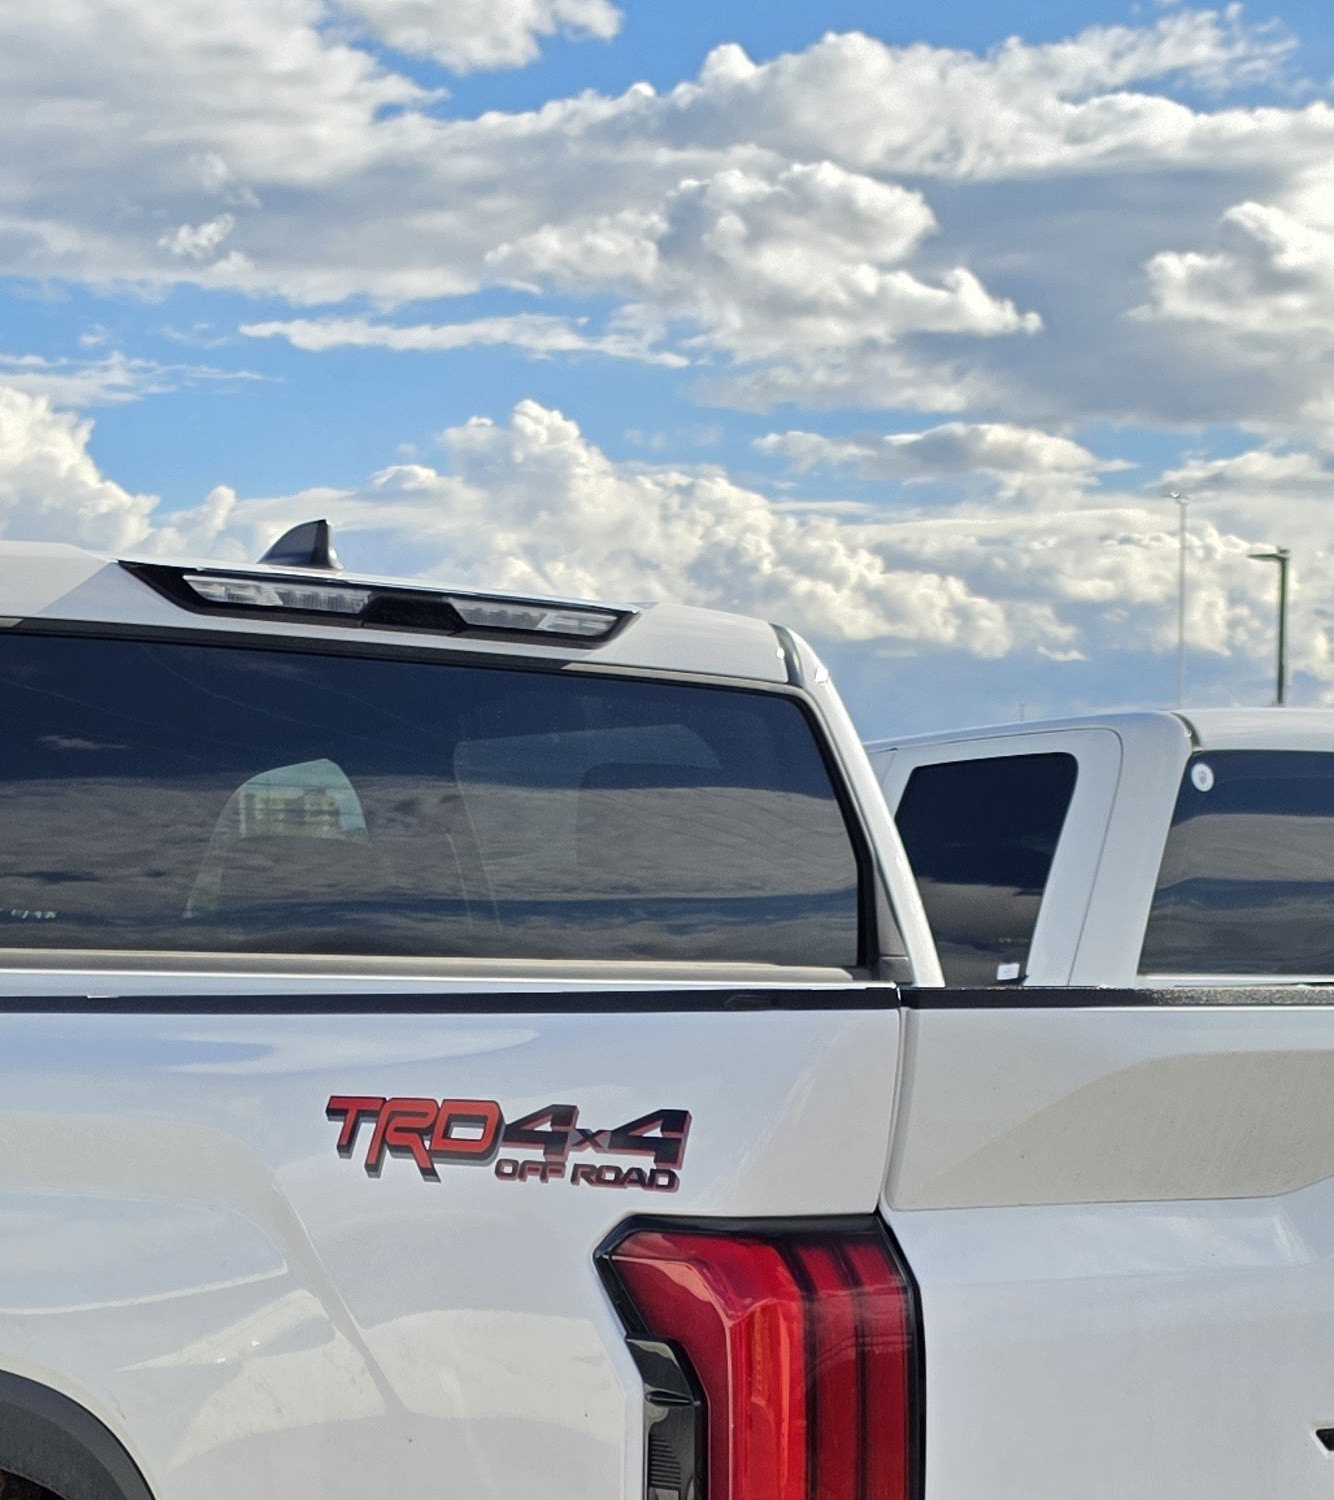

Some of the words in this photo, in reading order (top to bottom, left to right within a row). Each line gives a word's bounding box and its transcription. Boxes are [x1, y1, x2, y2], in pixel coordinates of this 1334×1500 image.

[325, 1095, 505, 1182] TRD
[494, 1158, 566, 1183] OFF
[570, 1163, 680, 1193] ROAD
